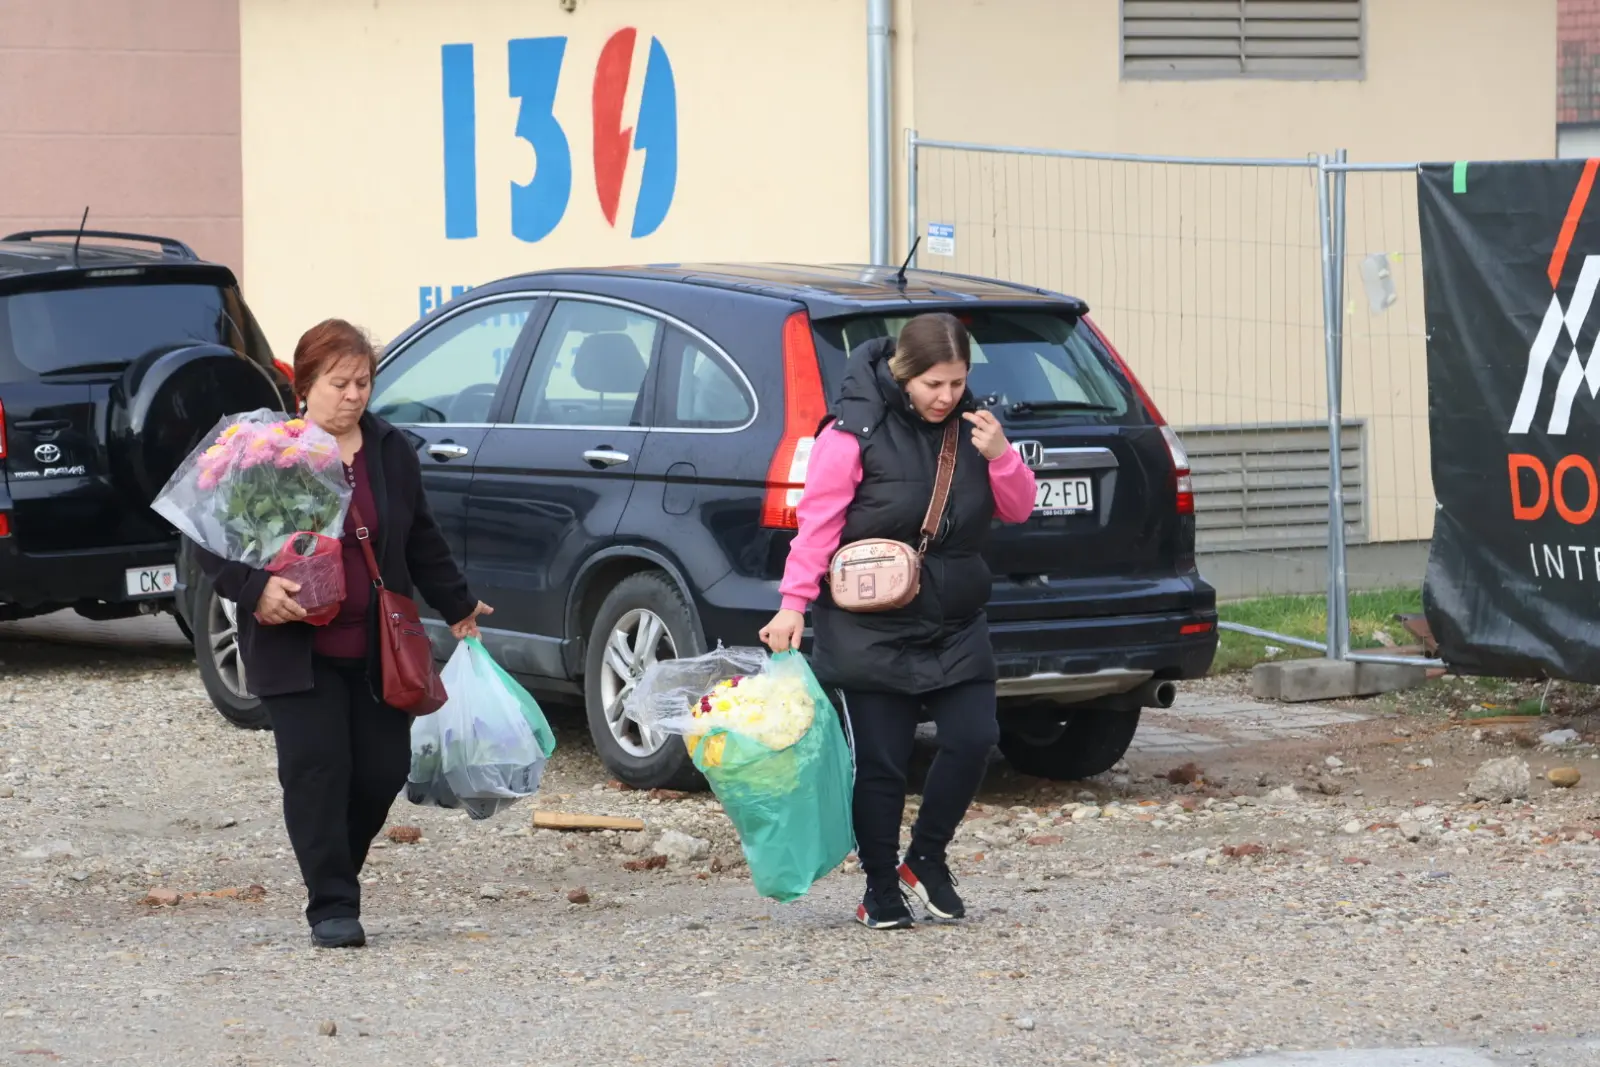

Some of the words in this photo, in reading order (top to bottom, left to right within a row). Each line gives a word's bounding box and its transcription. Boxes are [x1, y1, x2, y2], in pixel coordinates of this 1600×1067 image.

[441, 27, 678, 242] 130
[1508, 453, 1600, 525] DO
[140, 570, 161, 592] CK
